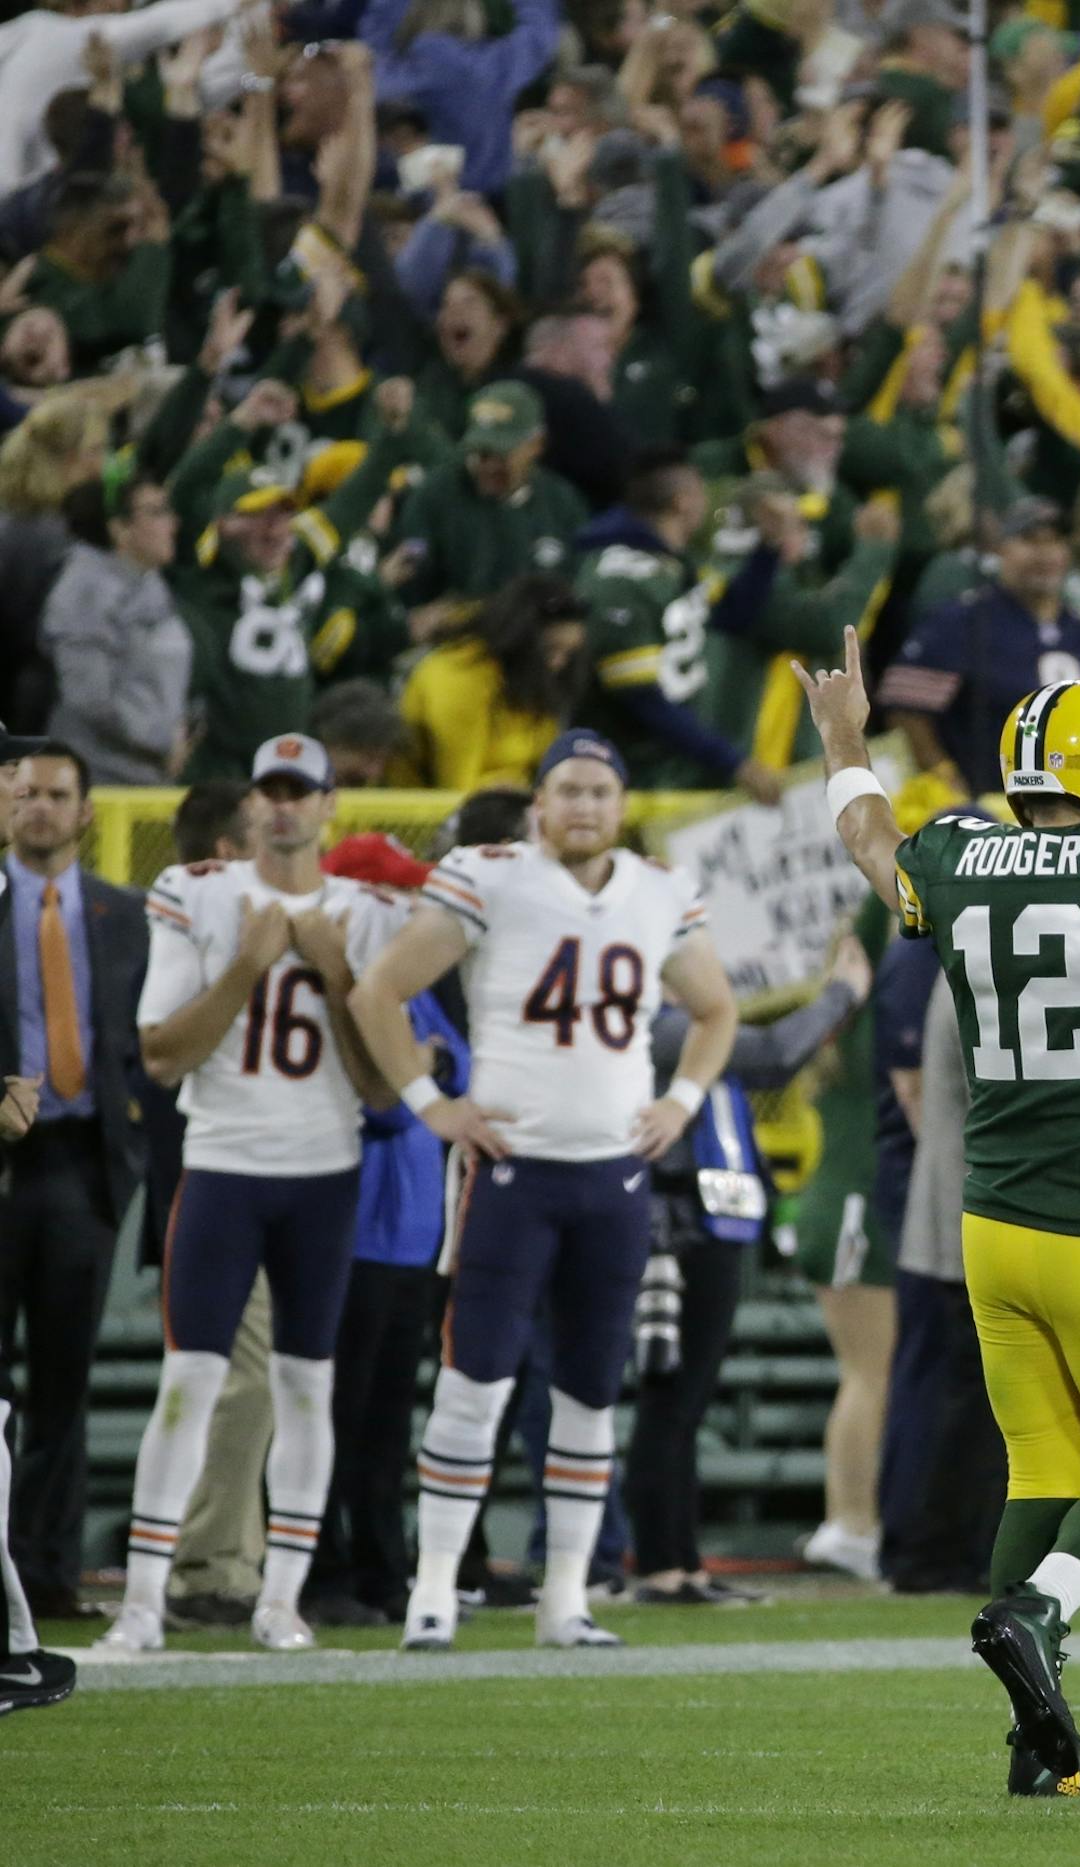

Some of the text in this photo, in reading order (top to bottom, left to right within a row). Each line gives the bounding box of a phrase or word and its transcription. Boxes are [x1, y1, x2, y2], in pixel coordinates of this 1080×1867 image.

[1013, 775, 1045, 786] PACKERS
[241, 965, 325, 1080] 16
[520, 934, 645, 1053] 48
